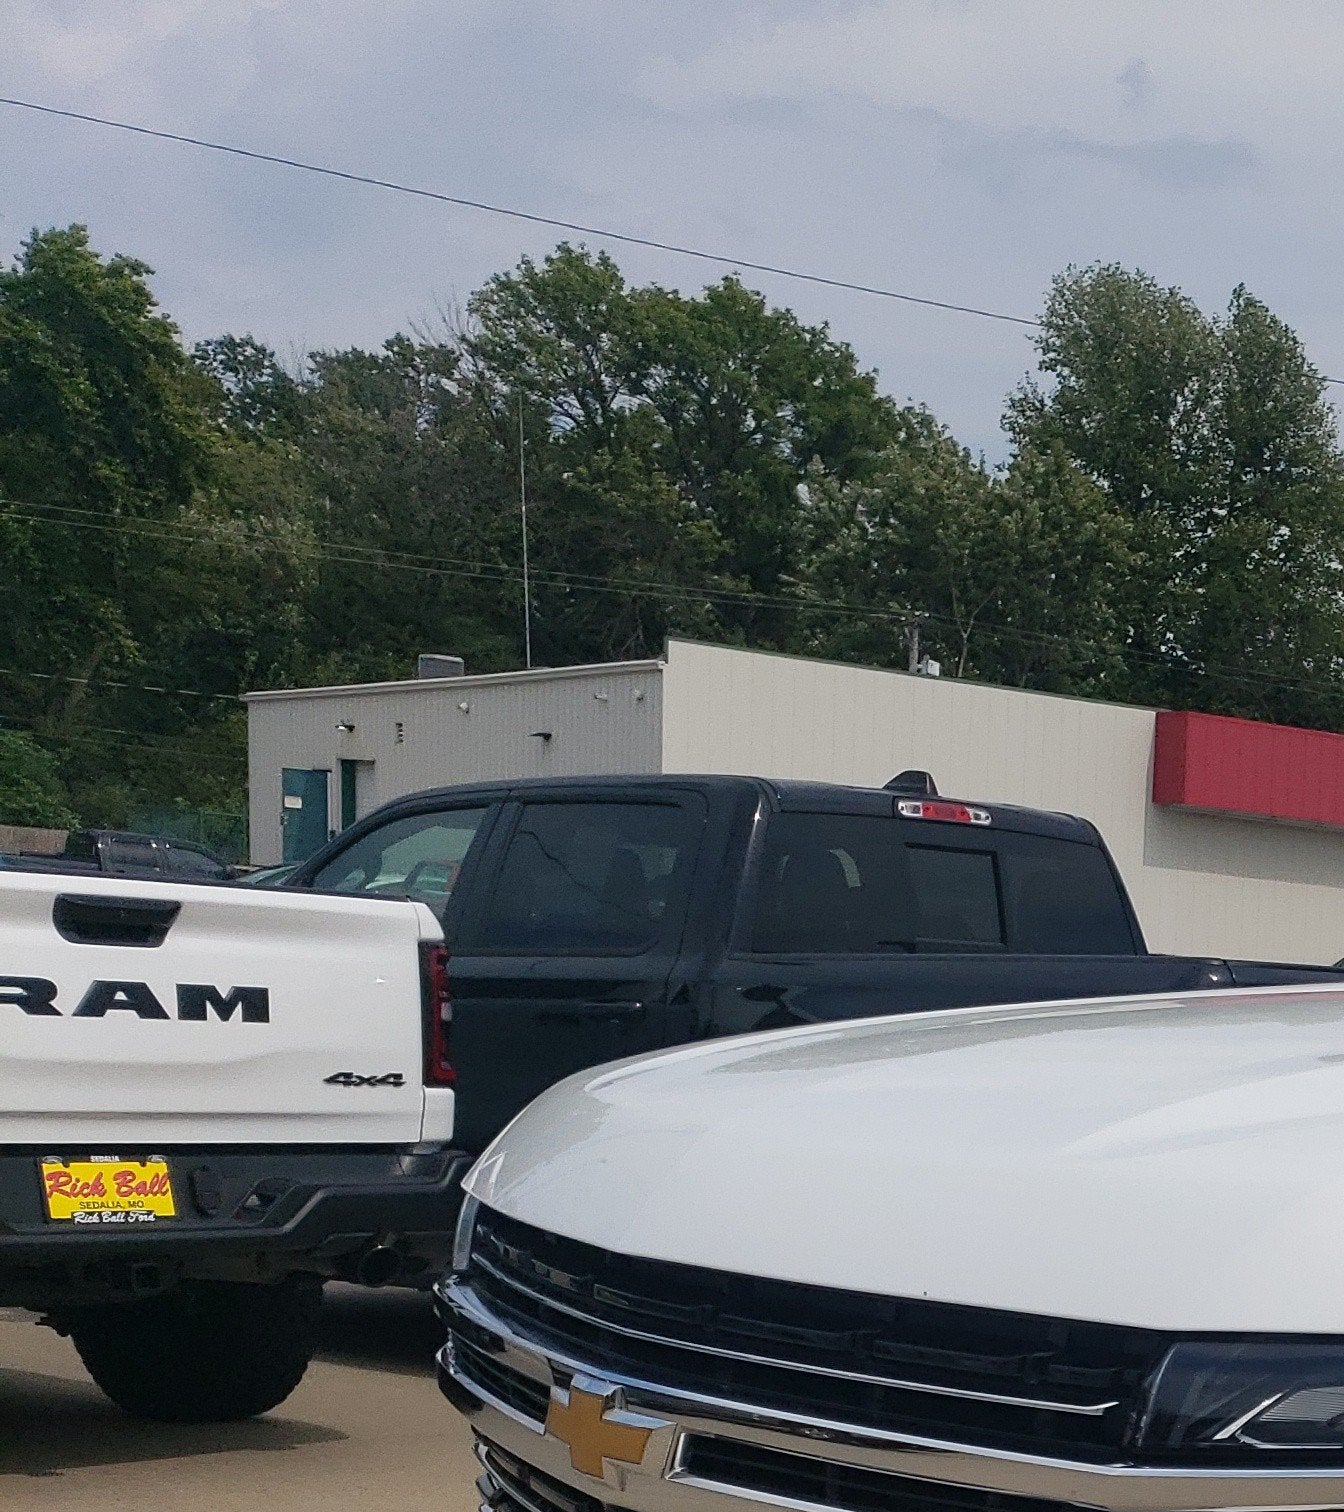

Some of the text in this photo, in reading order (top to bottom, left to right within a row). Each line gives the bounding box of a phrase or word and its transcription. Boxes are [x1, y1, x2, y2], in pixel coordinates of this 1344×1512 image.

[0, 975, 270, 1023] RAM
[323, 1071, 406, 1087] 4x4
[46, 1170, 170, 1198] Rick Ball
[128, 1200, 144, 1208] MO
[73, 1211, 156, 1223] Rick Ball Ford
